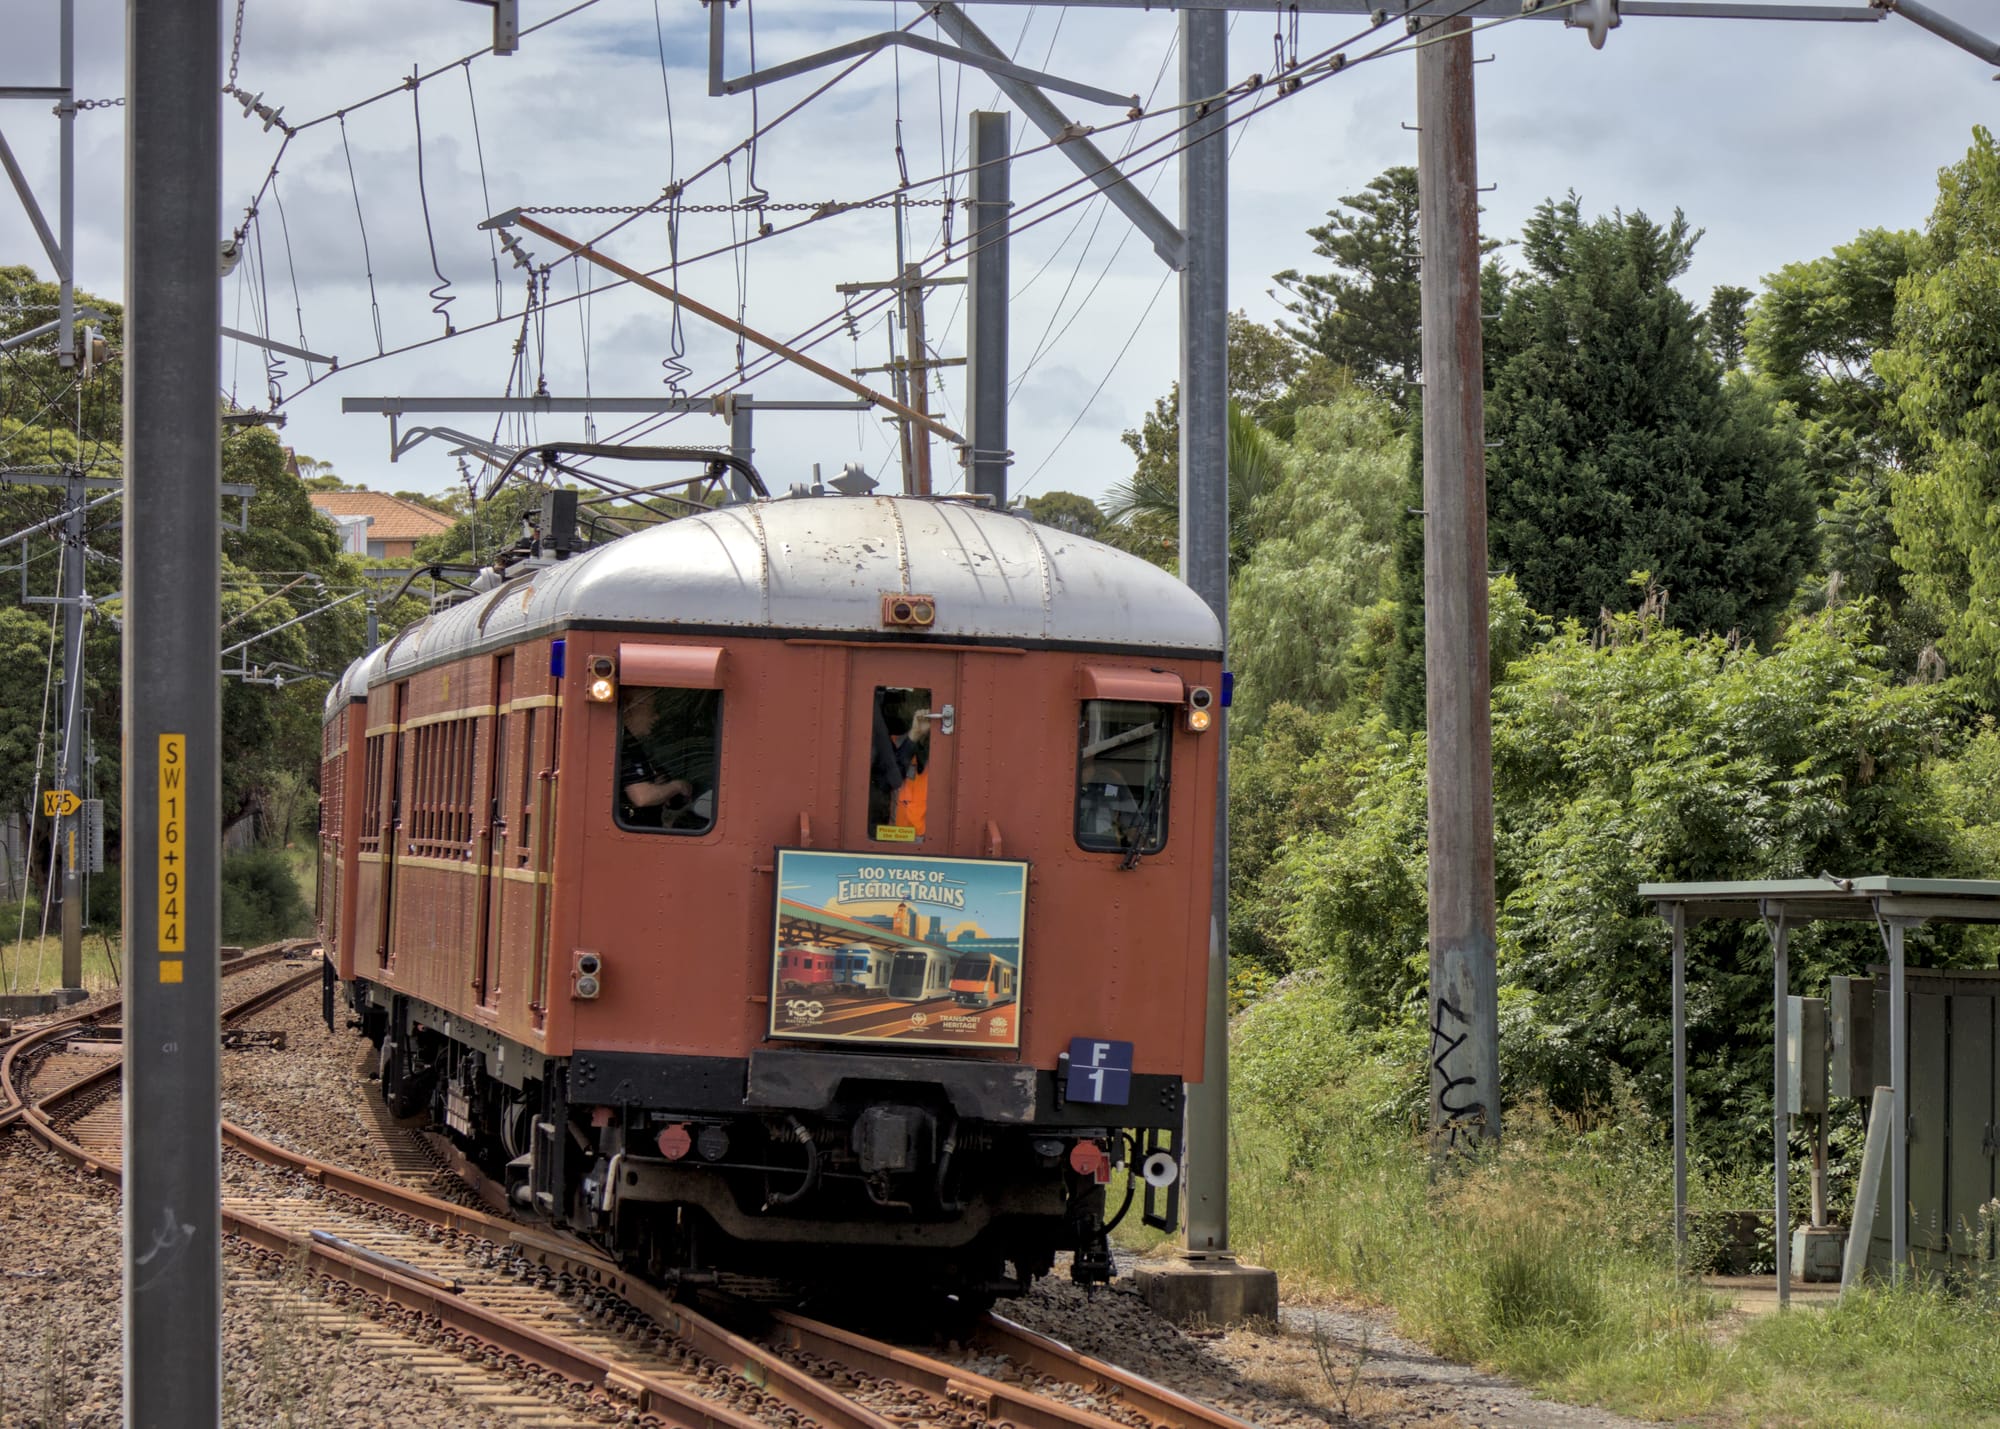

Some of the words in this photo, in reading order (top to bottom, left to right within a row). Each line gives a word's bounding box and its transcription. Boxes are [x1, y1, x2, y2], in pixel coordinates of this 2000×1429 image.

[858, 867, 885, 880] 100
[888, 869, 926, 882] YEARS
[928, 871, 945, 884] OF
[838, 880, 906, 903] ELECTRIC
[908, 881, 966, 907] TRAINS
[785, 1000, 824, 1017] 100
[940, 1015, 981, 1023] TRANSPORT
[943, 1021, 977, 1029] HERITAGE
[1092, 1043, 1110, 1066] F
[1088, 1069, 1104, 1102] 1
